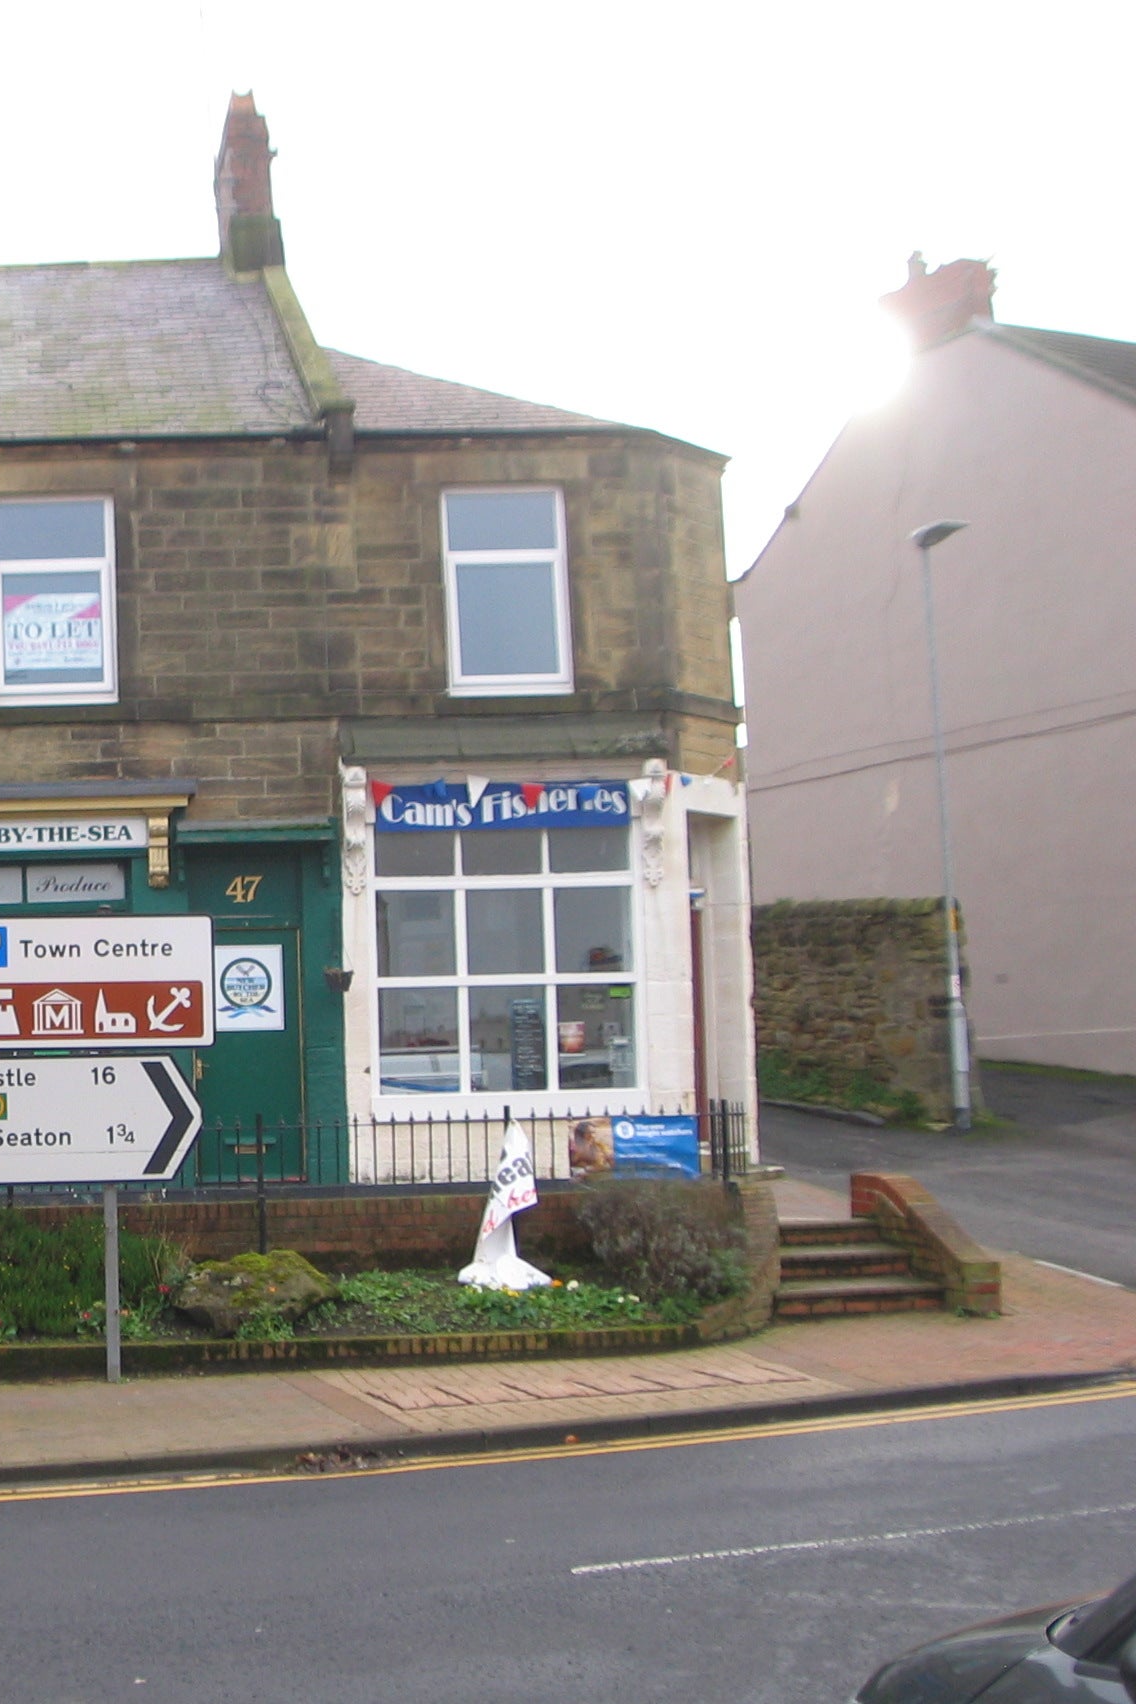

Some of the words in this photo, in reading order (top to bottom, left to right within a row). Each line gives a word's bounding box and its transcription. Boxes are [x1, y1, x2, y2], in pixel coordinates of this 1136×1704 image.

[7, 621, 43, 640] TO
[50, 619, 99, 639] LET
[380, 793, 473, 827] Cam's
[481, 787, 628, 825] Fiseres
[35, 875, 113, 895] Produce
[225, 875, 262, 903] 47
[19, 939, 81, 958] Town
[93, 938, 173, 957] Centre
[91, 1066, 116, 1085] 16
